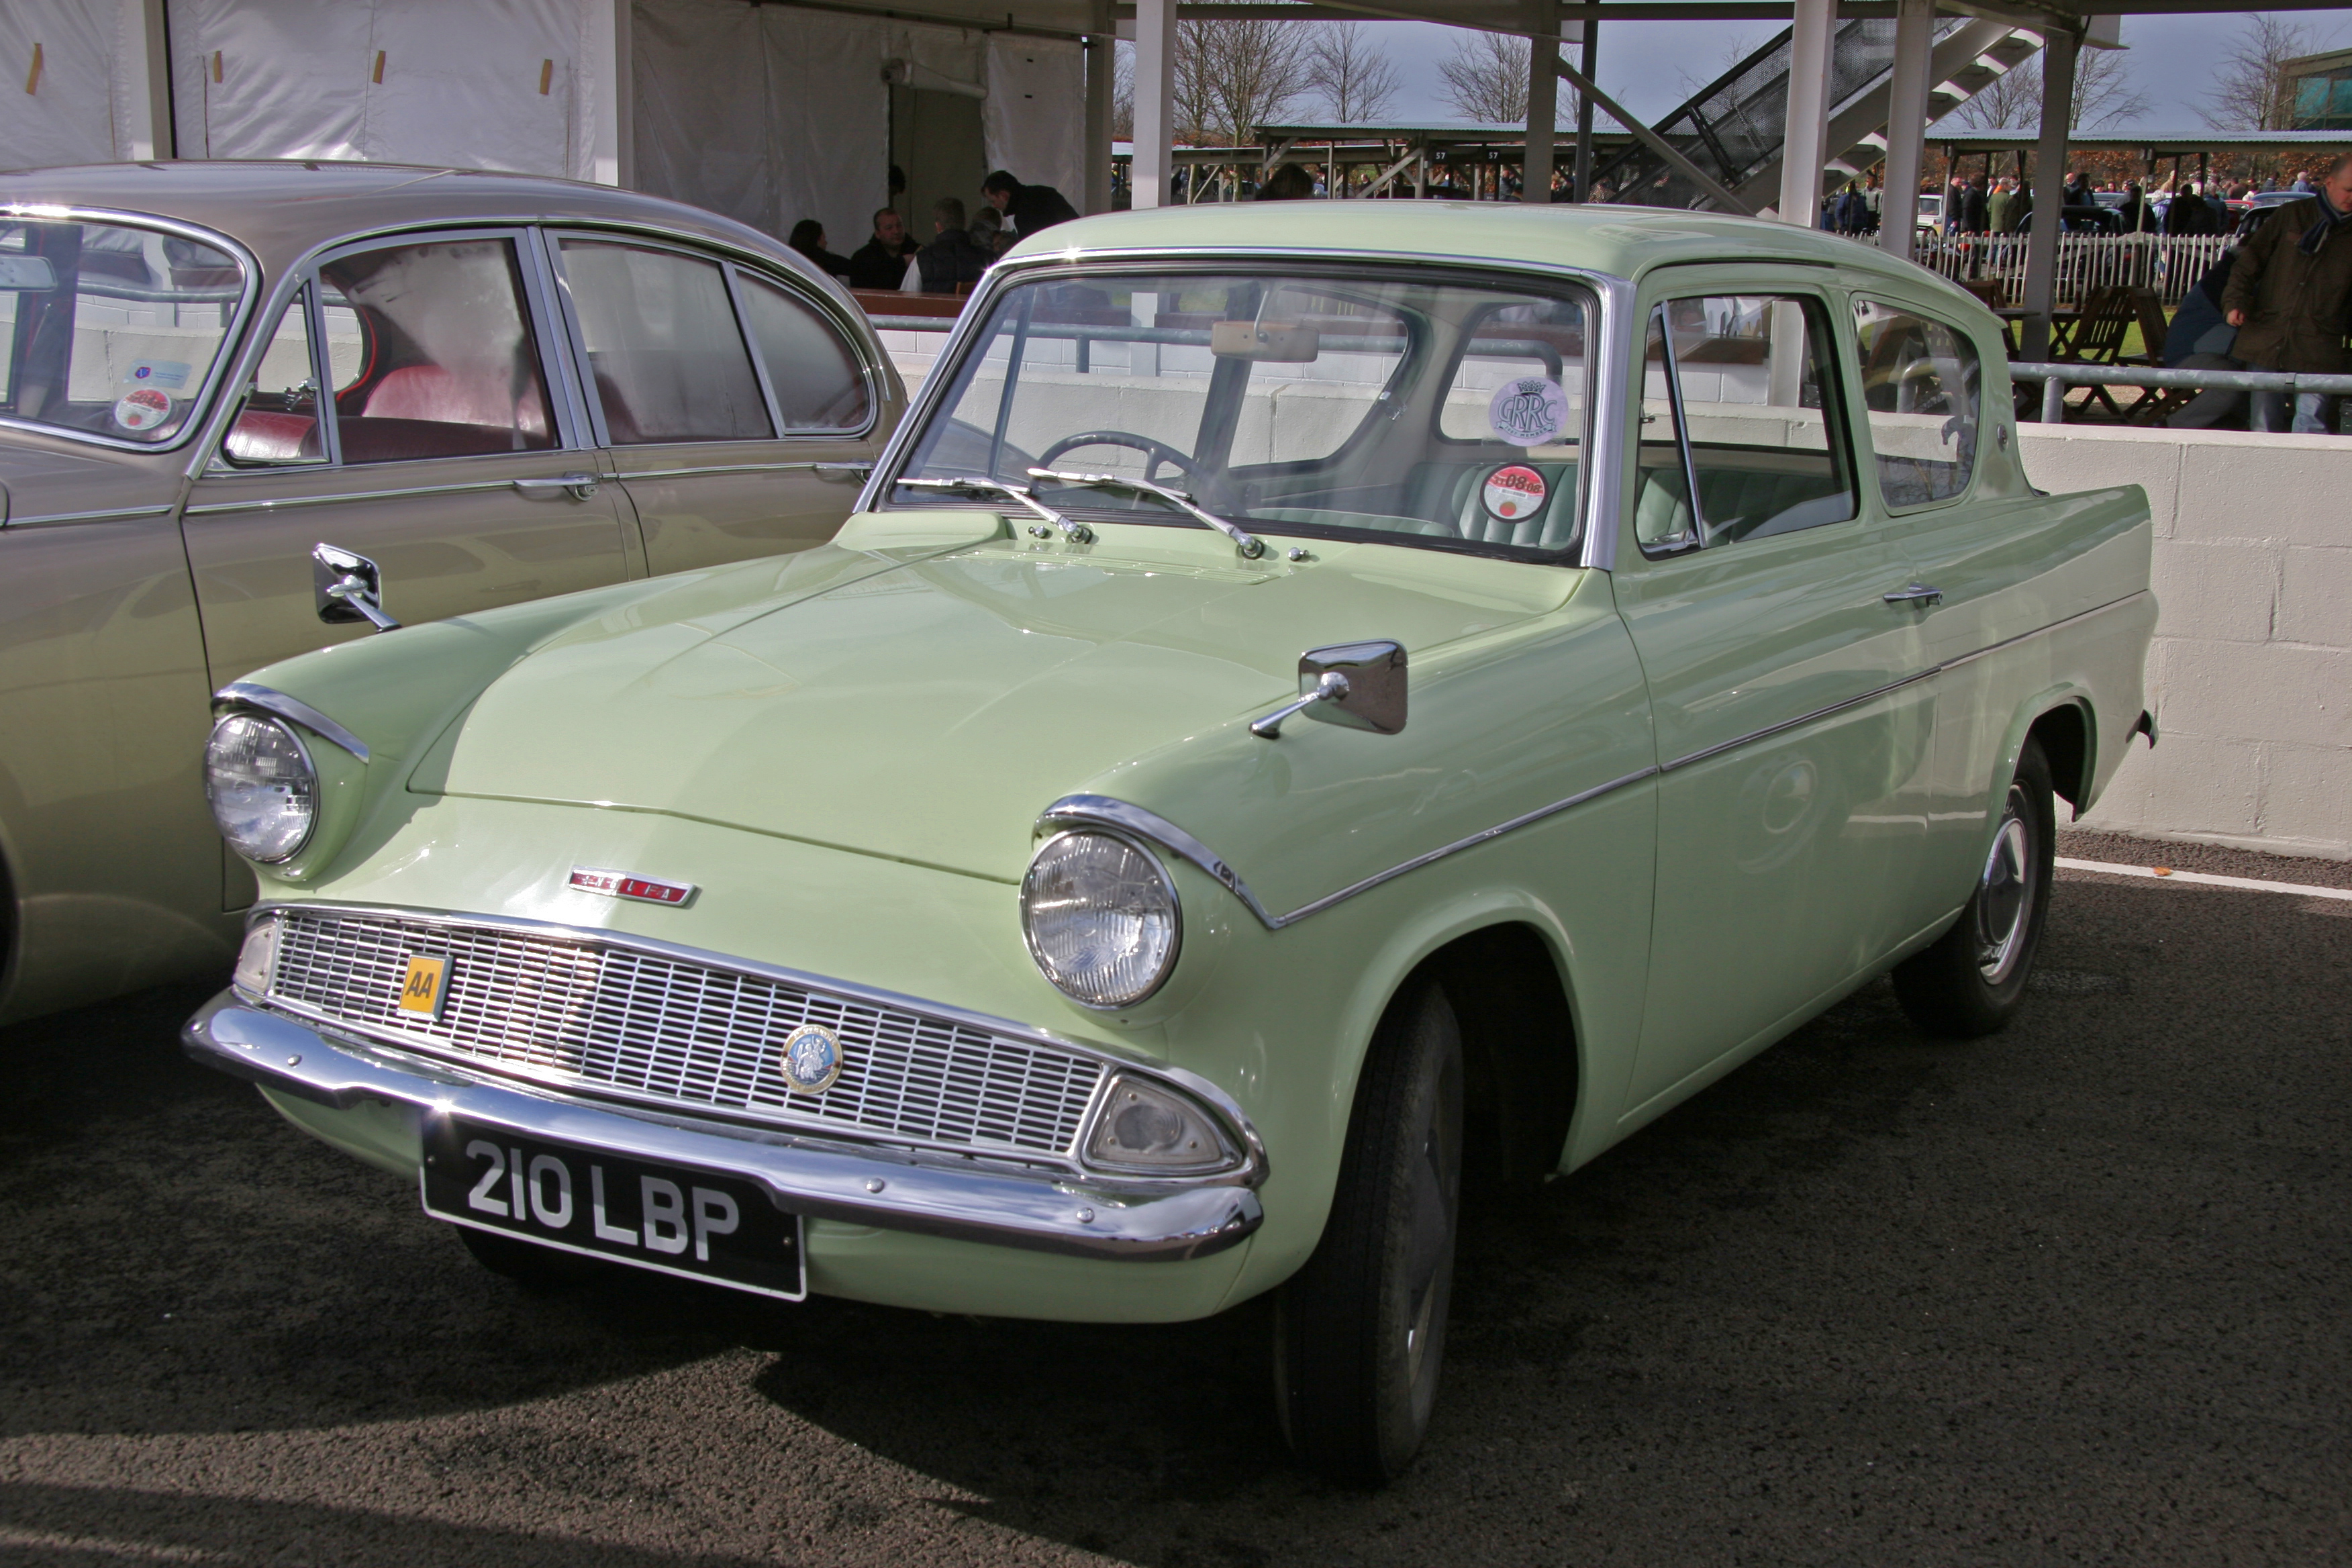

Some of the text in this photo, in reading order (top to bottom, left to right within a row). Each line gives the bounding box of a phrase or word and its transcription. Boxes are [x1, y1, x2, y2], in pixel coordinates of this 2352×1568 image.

[1436, 152, 1446, 160] 57
[1498, 394, 1557, 432] GRRC
[1520, 427, 1548, 438] MEMBER
[1506, 474, 1526, 489] 08
[1526, 483, 1541, 493] 08
[405, 971, 434, 999] AA
[466, 1139, 740, 1261] 210 LBP
